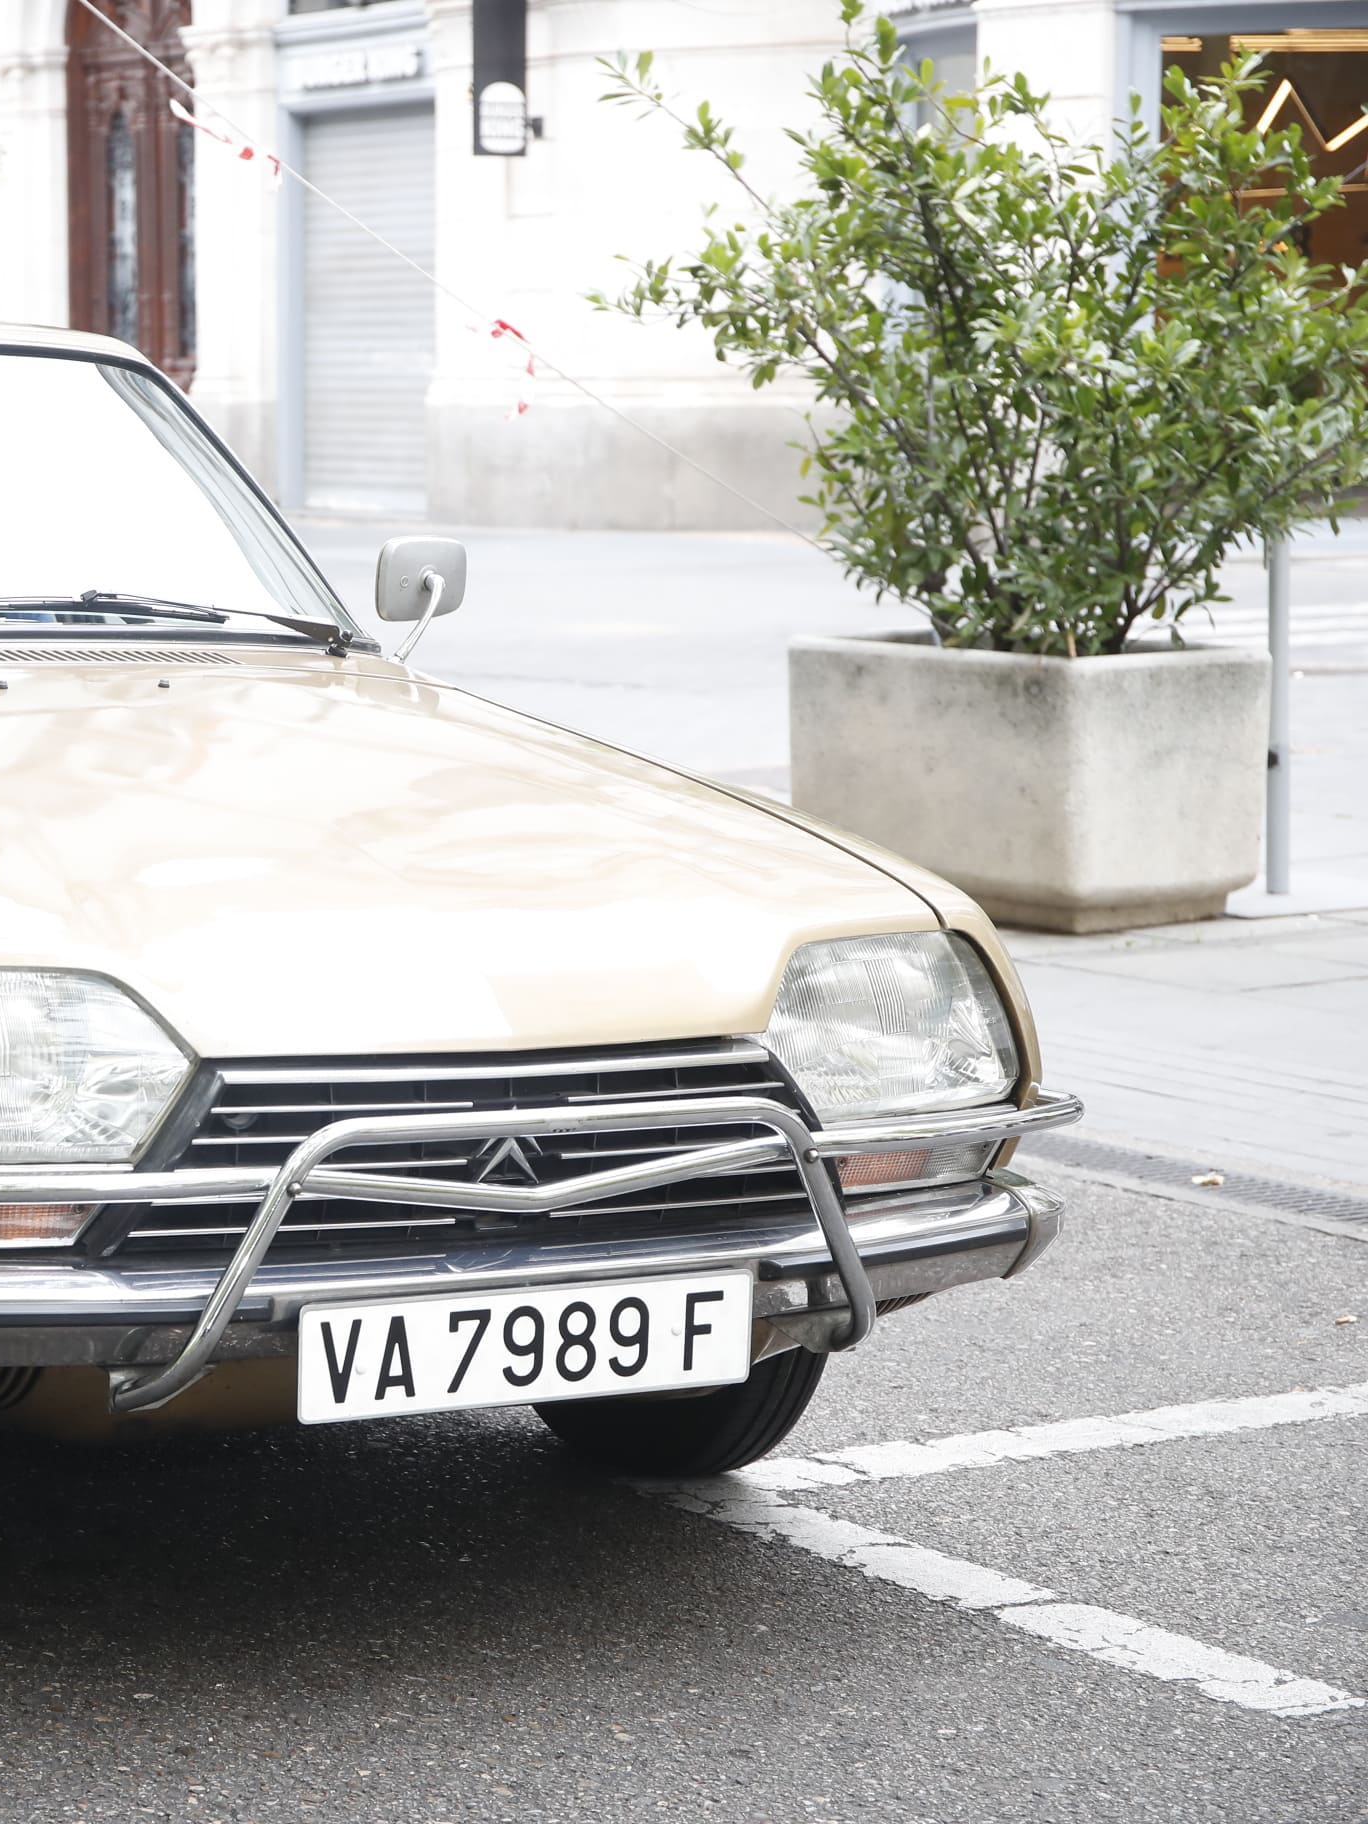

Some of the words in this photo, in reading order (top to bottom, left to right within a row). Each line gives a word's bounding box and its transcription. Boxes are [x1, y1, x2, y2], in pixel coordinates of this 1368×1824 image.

[320, 1315, 416, 1404] VA
[447, 1296, 650, 1394] 7989
[683, 1290, 724, 1371] F
